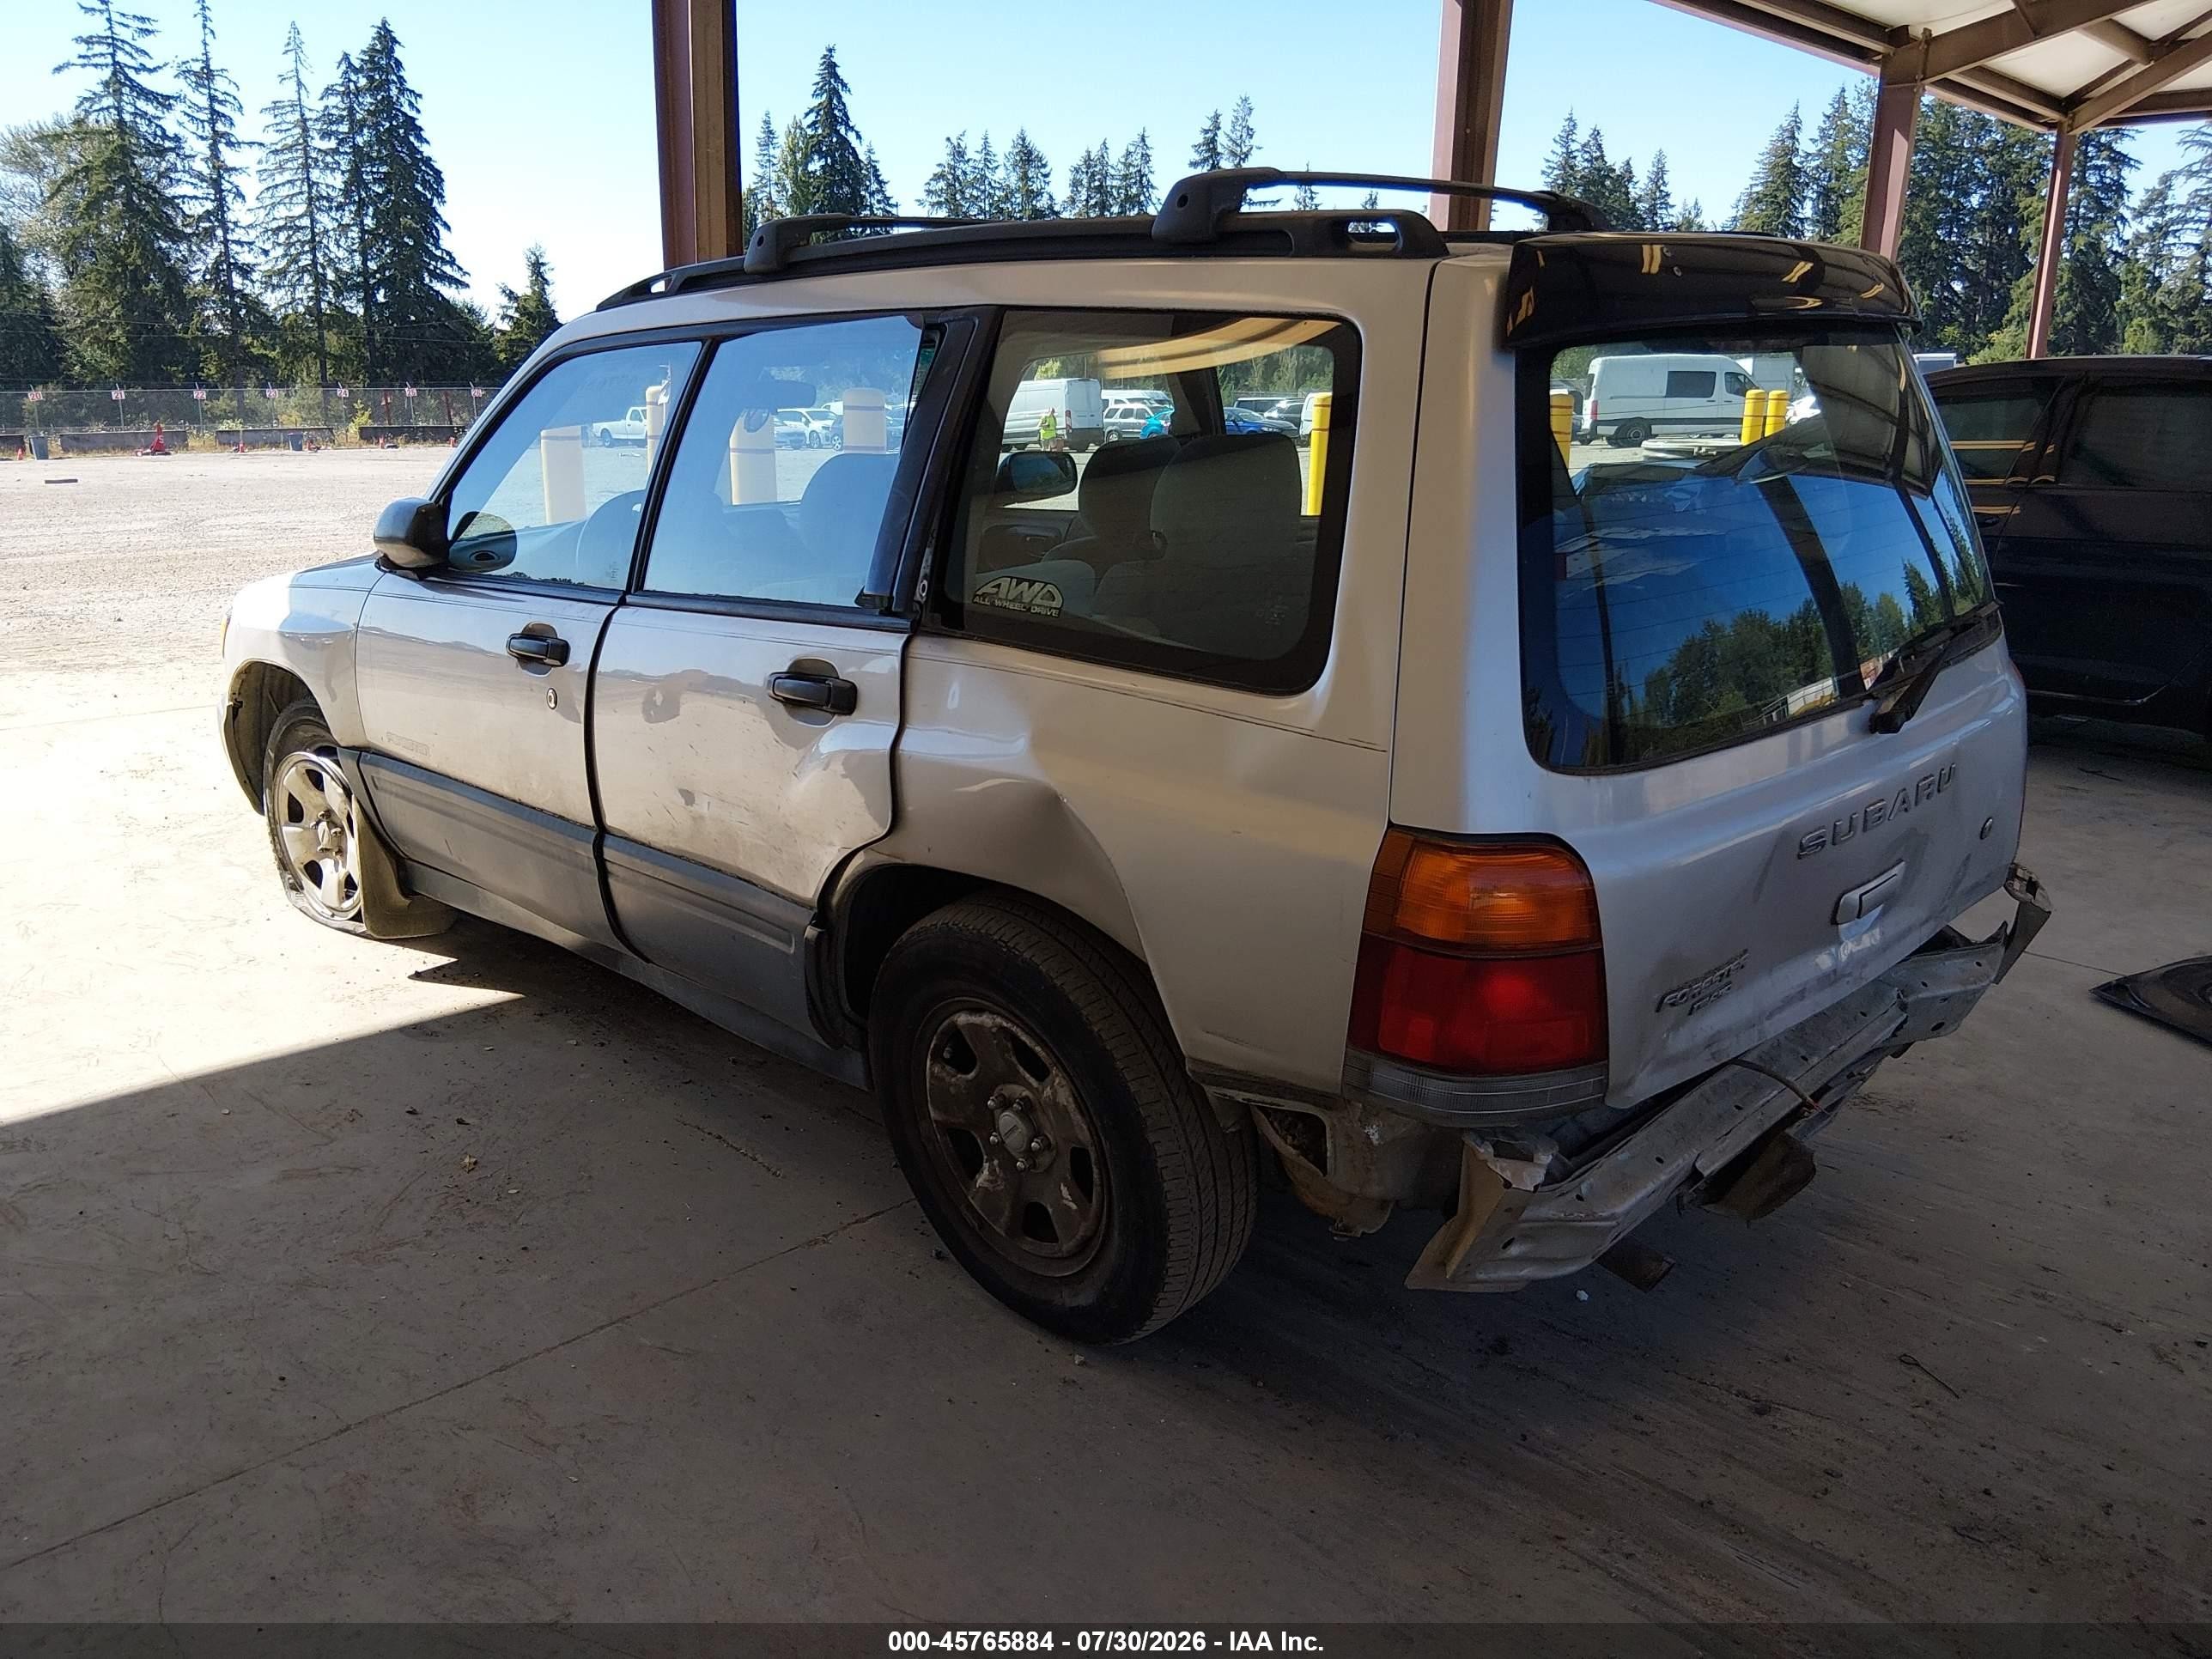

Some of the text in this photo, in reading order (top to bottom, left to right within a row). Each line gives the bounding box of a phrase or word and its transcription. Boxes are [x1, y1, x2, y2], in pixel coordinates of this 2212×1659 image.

[113, 391, 125, 399] 21
[975, 577, 1063, 608] AWD
[973, 595, 1059, 617] ALL WHEEL DRIVE
[1797, 763, 1956, 860] SUBARU
